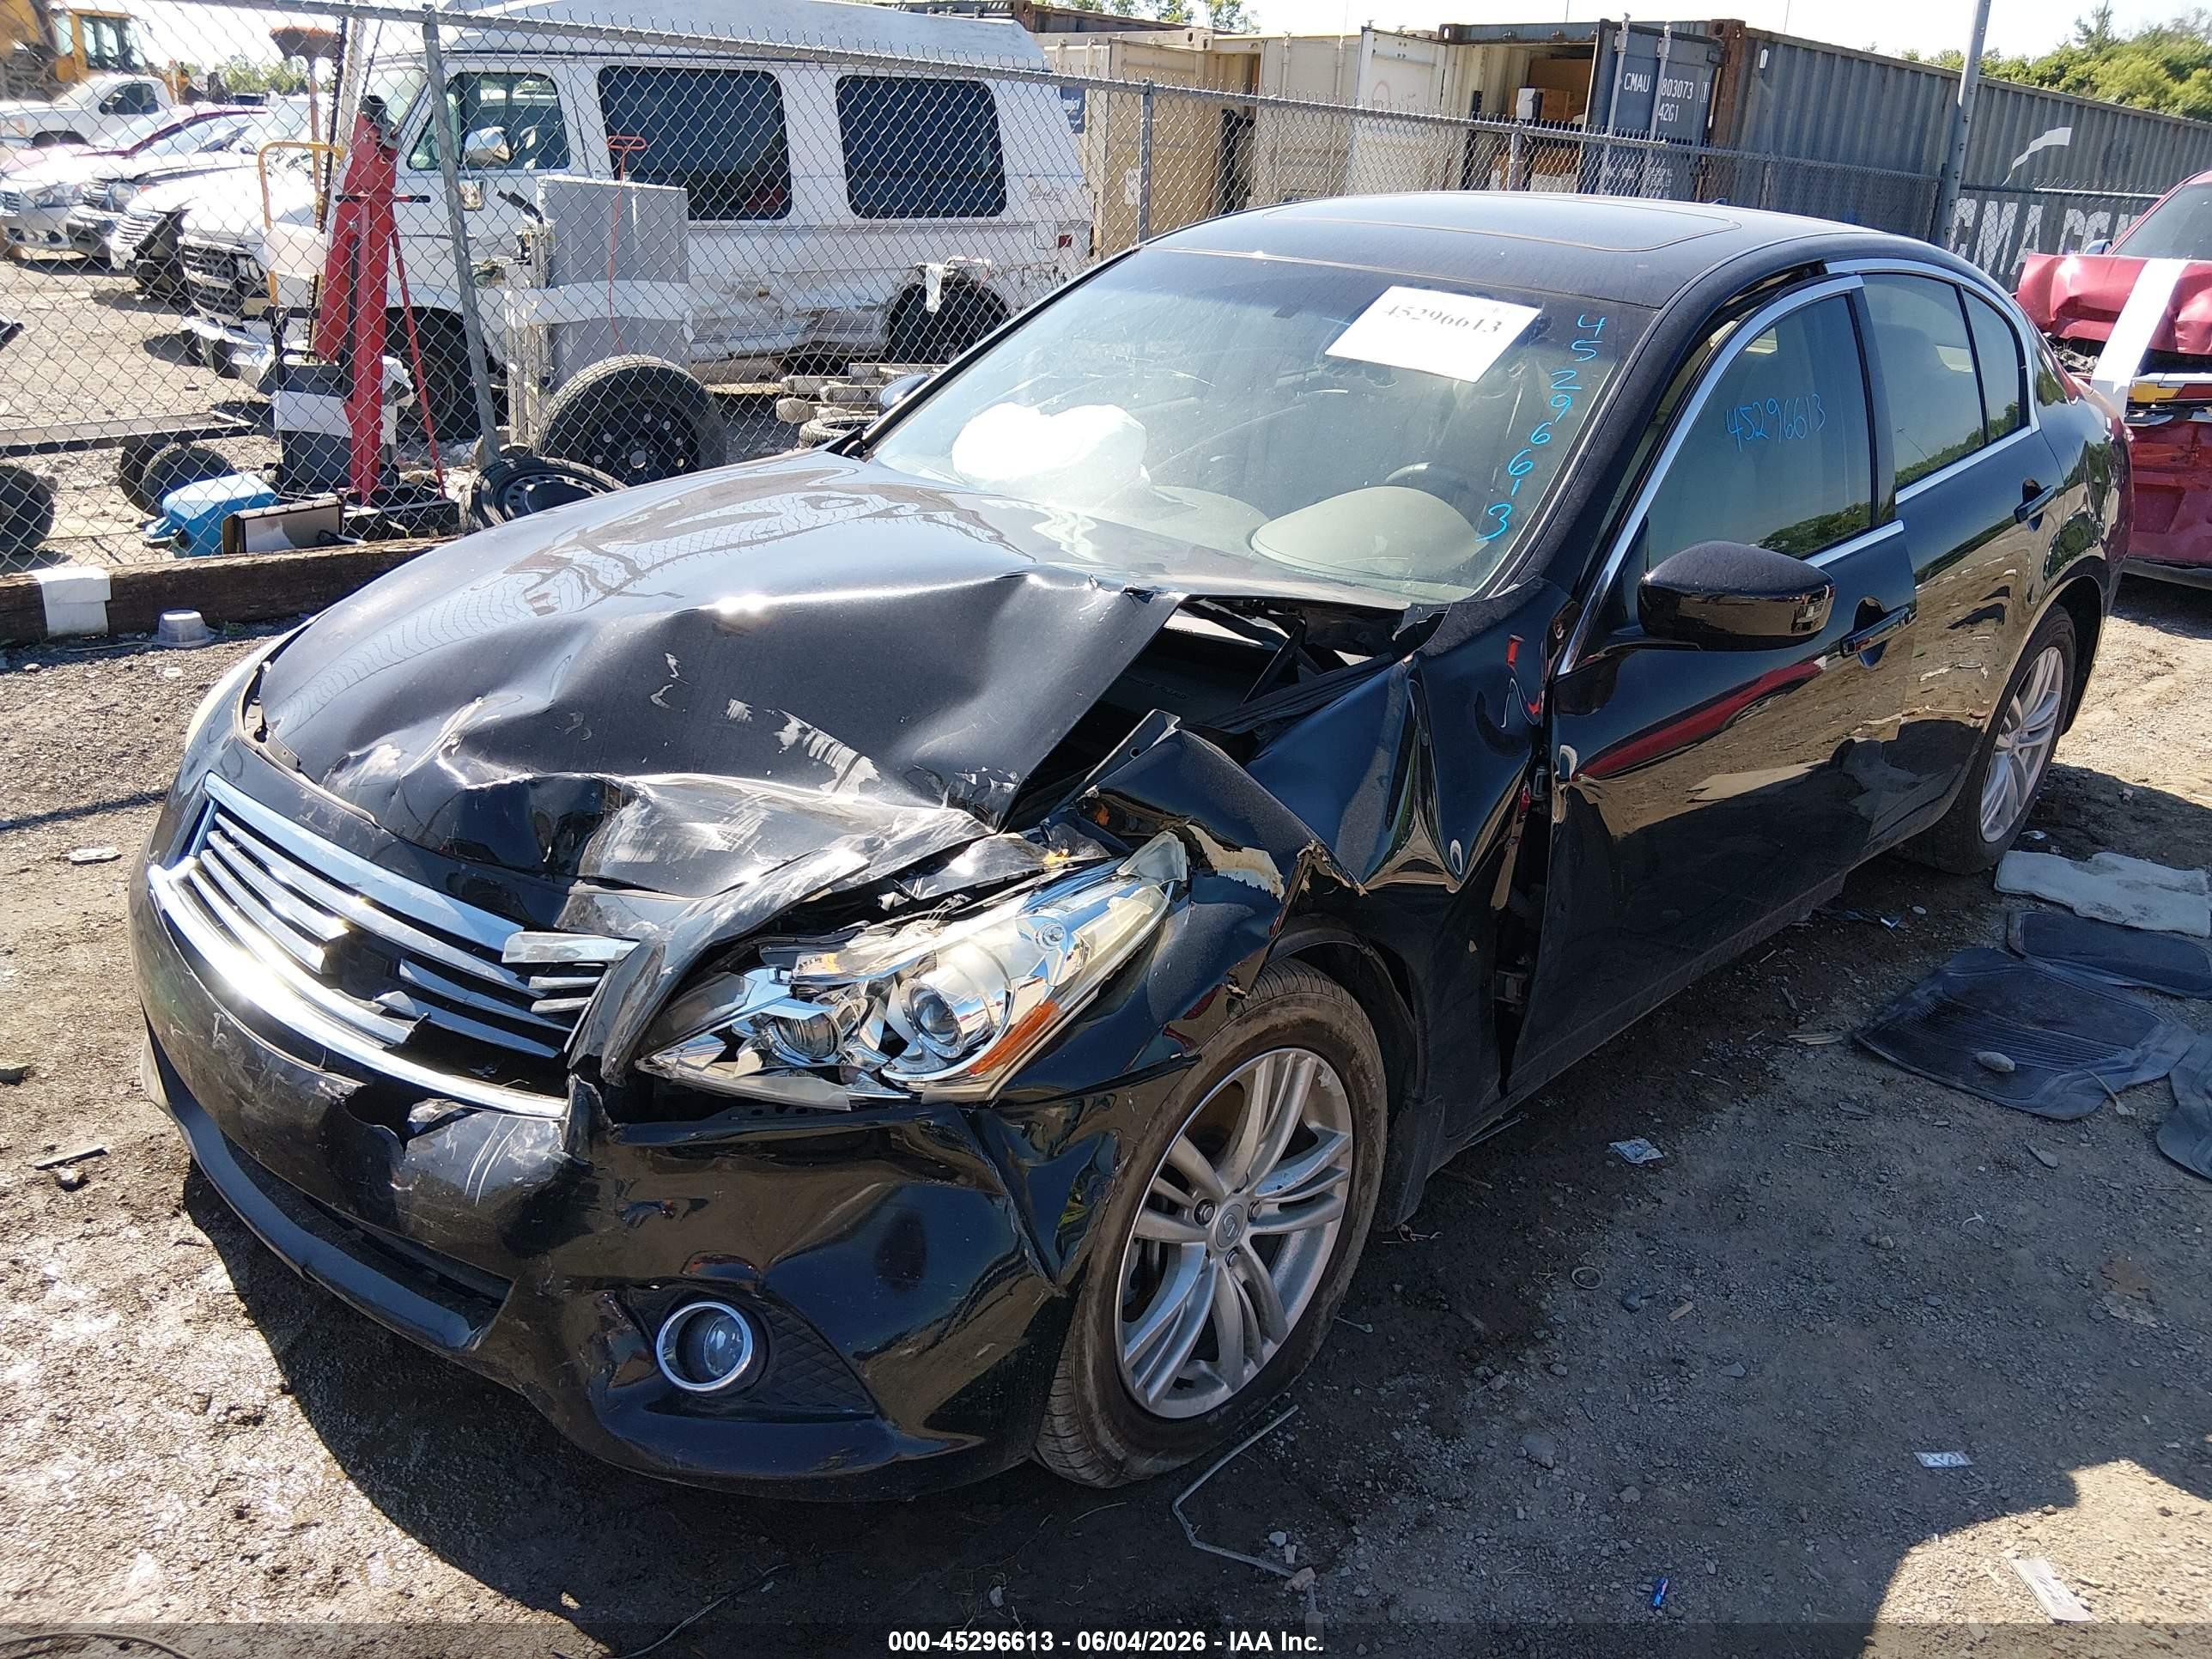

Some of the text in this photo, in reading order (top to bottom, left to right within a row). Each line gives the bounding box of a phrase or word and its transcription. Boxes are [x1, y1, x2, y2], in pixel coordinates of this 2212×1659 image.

[1624, 72, 1650, 93] CMAU
[1661, 78, 1694, 100] 803073
[1658, 103, 1679, 122] 42G1
[1949, 198, 2044, 276] CMA
[1725, 392, 1826, 453] 45296613
